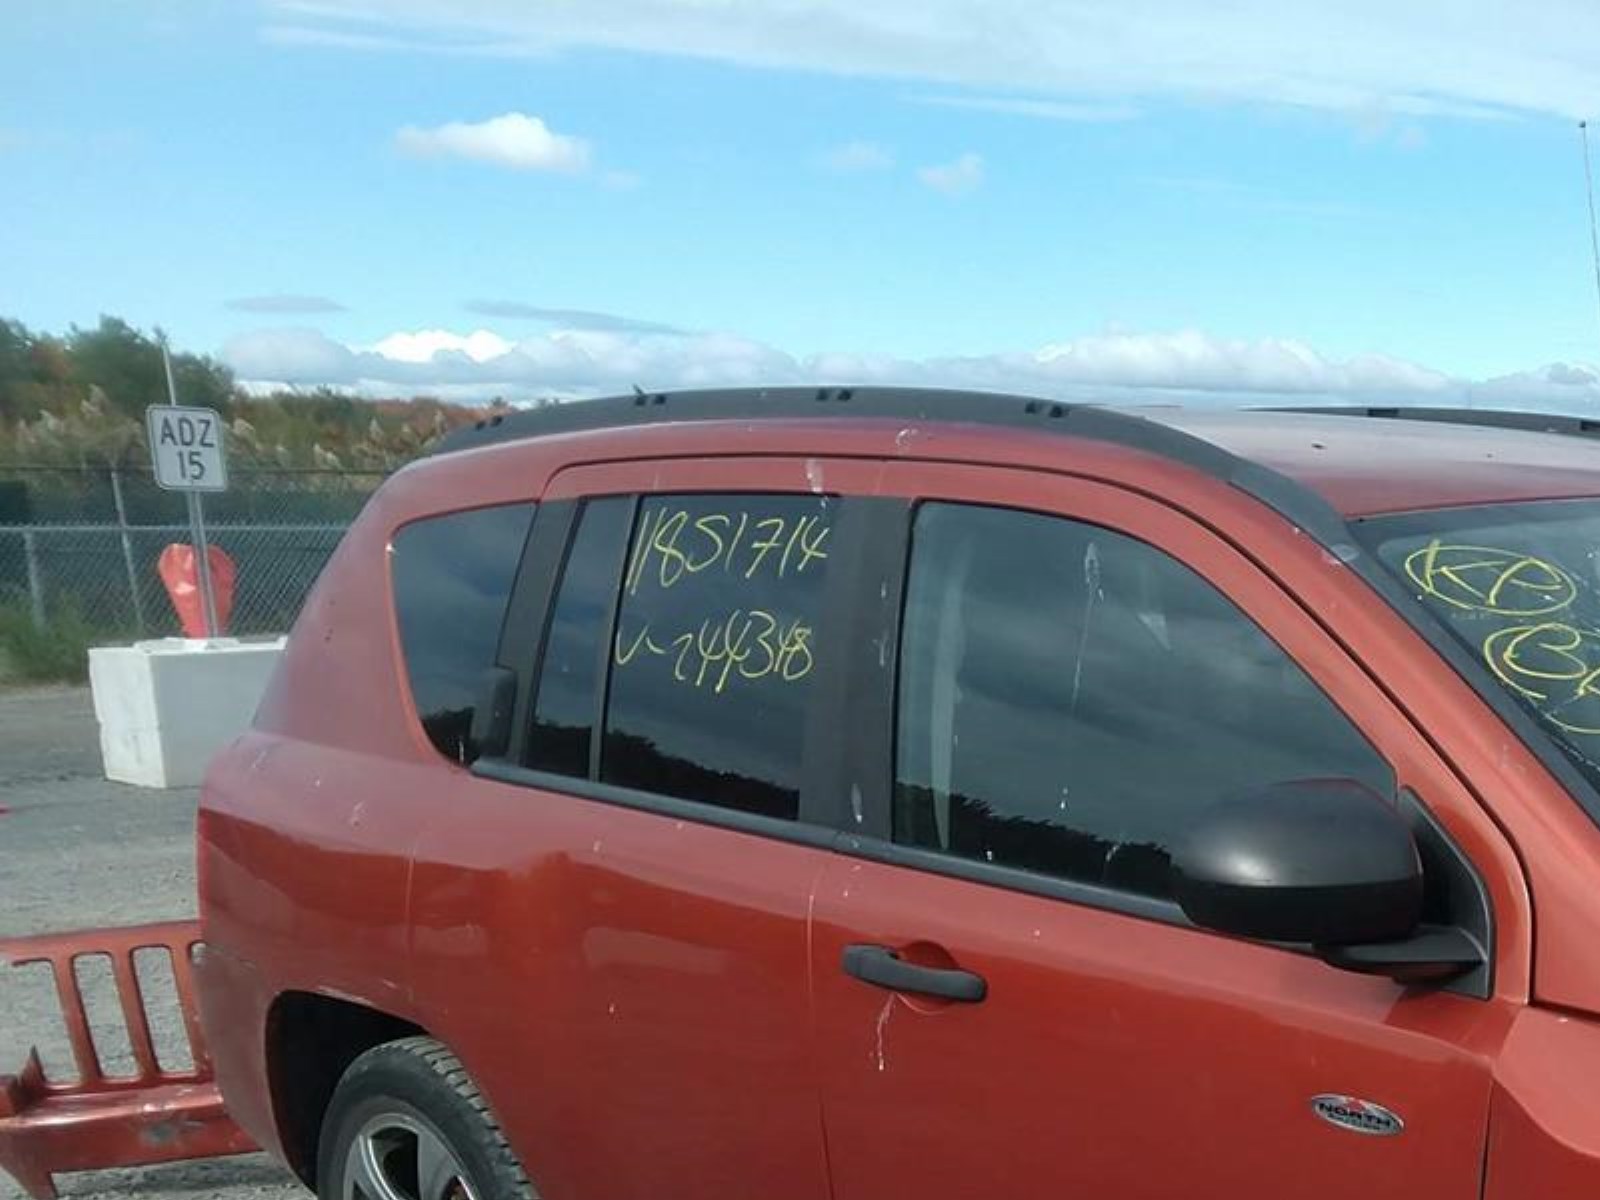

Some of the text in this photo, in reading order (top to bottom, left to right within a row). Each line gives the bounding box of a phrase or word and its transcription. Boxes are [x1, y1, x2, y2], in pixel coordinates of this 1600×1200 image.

[160, 416, 215, 448] ADZ
[177, 450, 206, 480] 15
[624, 506, 830, 596] 11851714
